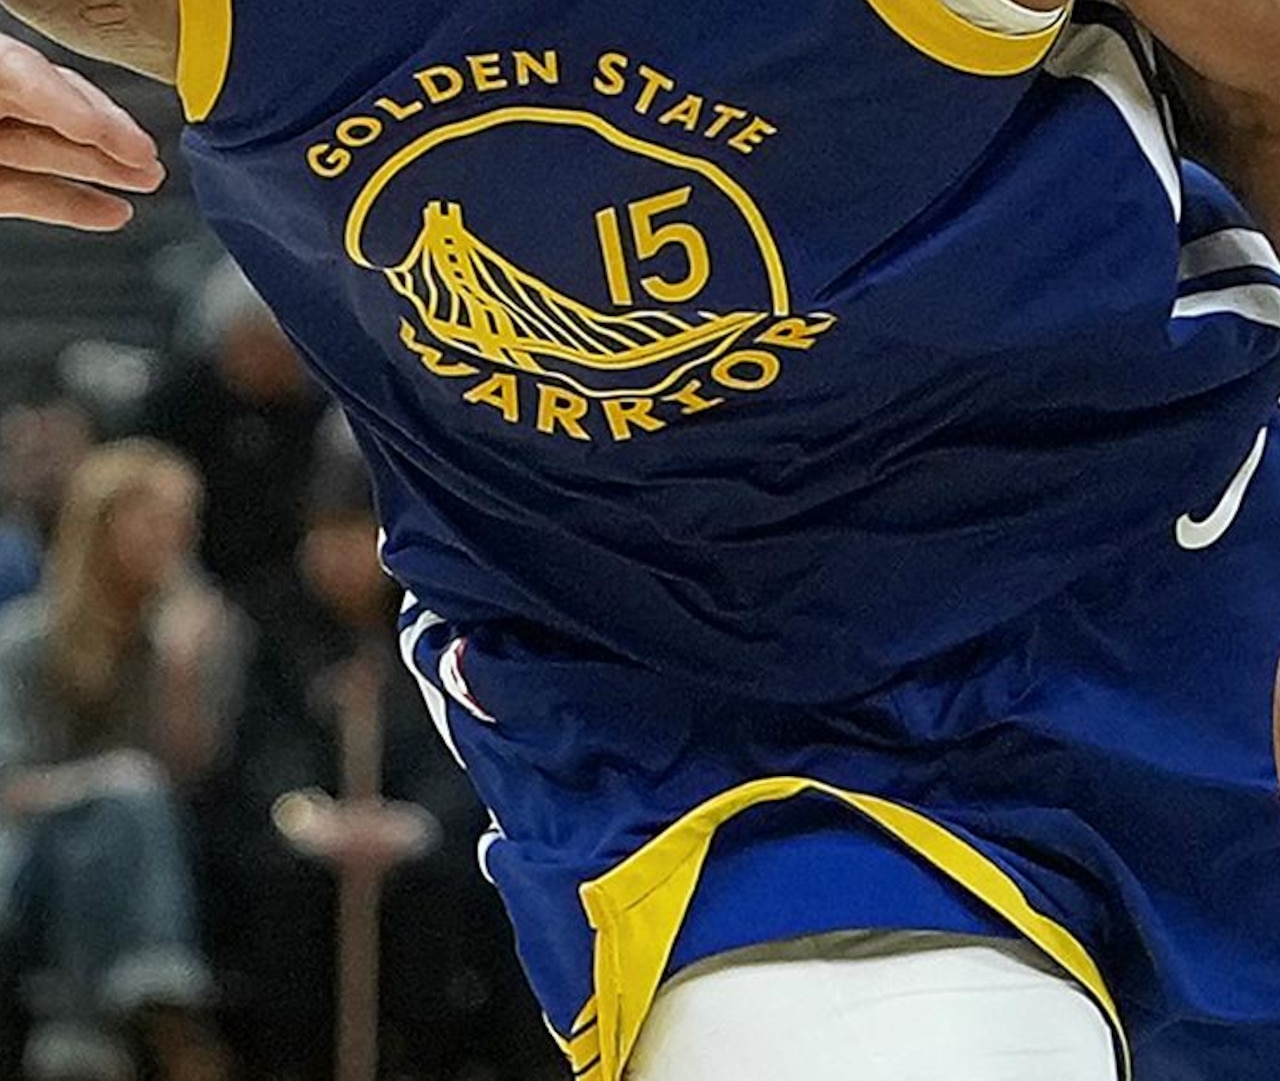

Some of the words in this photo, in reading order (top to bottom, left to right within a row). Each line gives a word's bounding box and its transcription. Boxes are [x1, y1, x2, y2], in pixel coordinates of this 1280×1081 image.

[306, 50, 559, 178] GOLDEN
[593, 52, 778, 154] STATE
[595, 185, 711, 307] 15
[401, 311, 838, 442] WARRIOR
